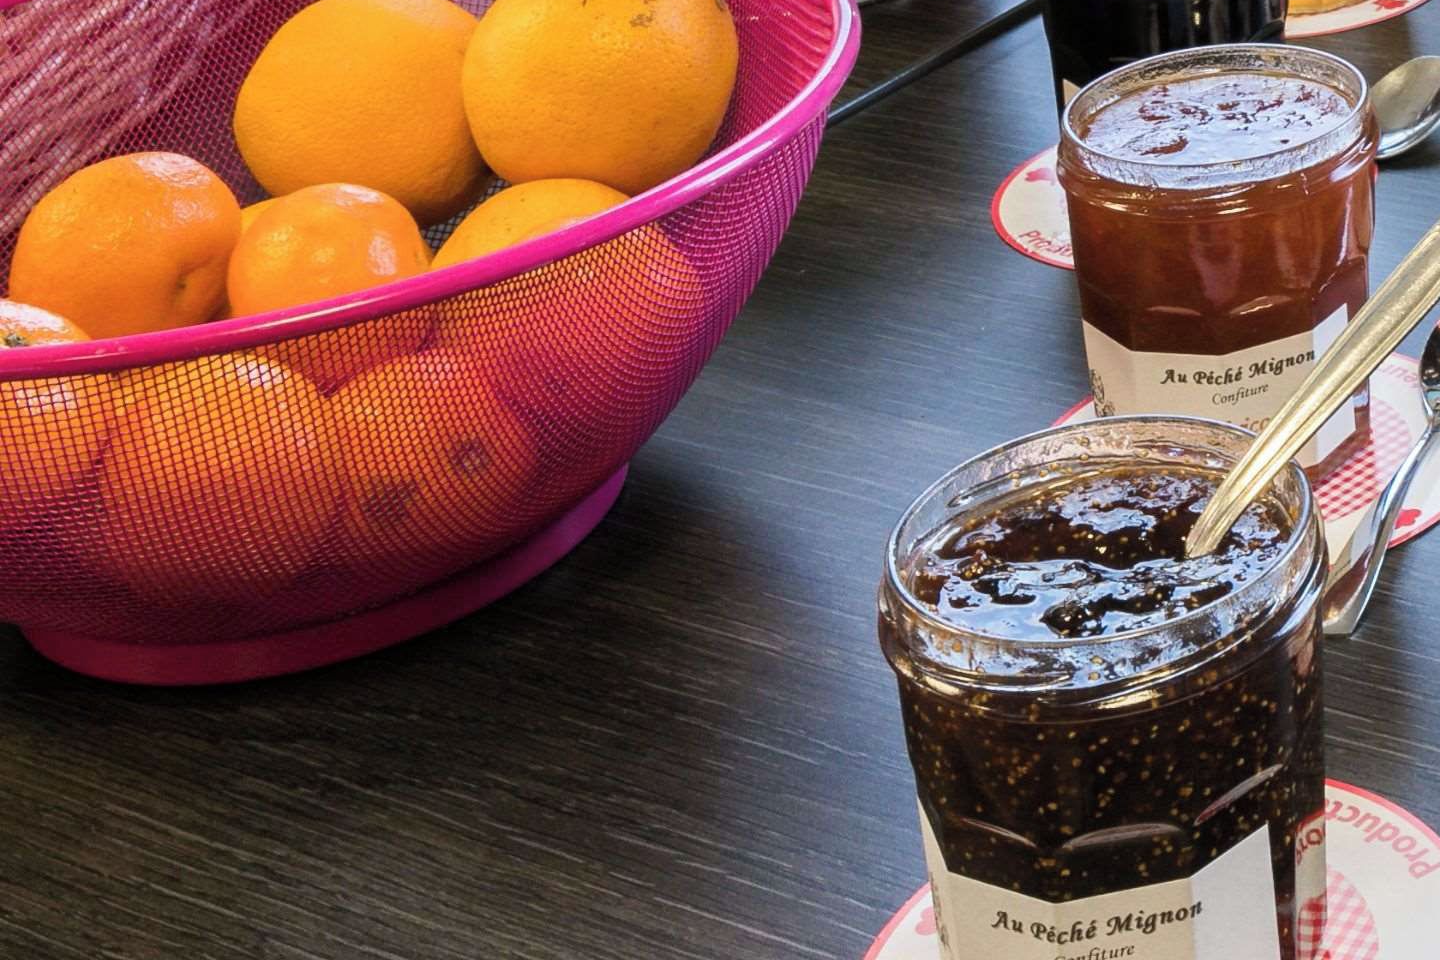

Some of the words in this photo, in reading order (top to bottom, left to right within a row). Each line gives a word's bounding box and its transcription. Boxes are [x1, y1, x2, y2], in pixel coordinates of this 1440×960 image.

[1160, 369, 1188, 385] Au
[1193, 366, 1243, 386] Péché
[1249, 349, 1315, 379] Mignon
[1212, 383, 1269, 406] Confiture
[991, 910, 1024, 934] Au
[1030, 919, 1097, 945] Péché
[1106, 901, 1203, 936] Mignon
